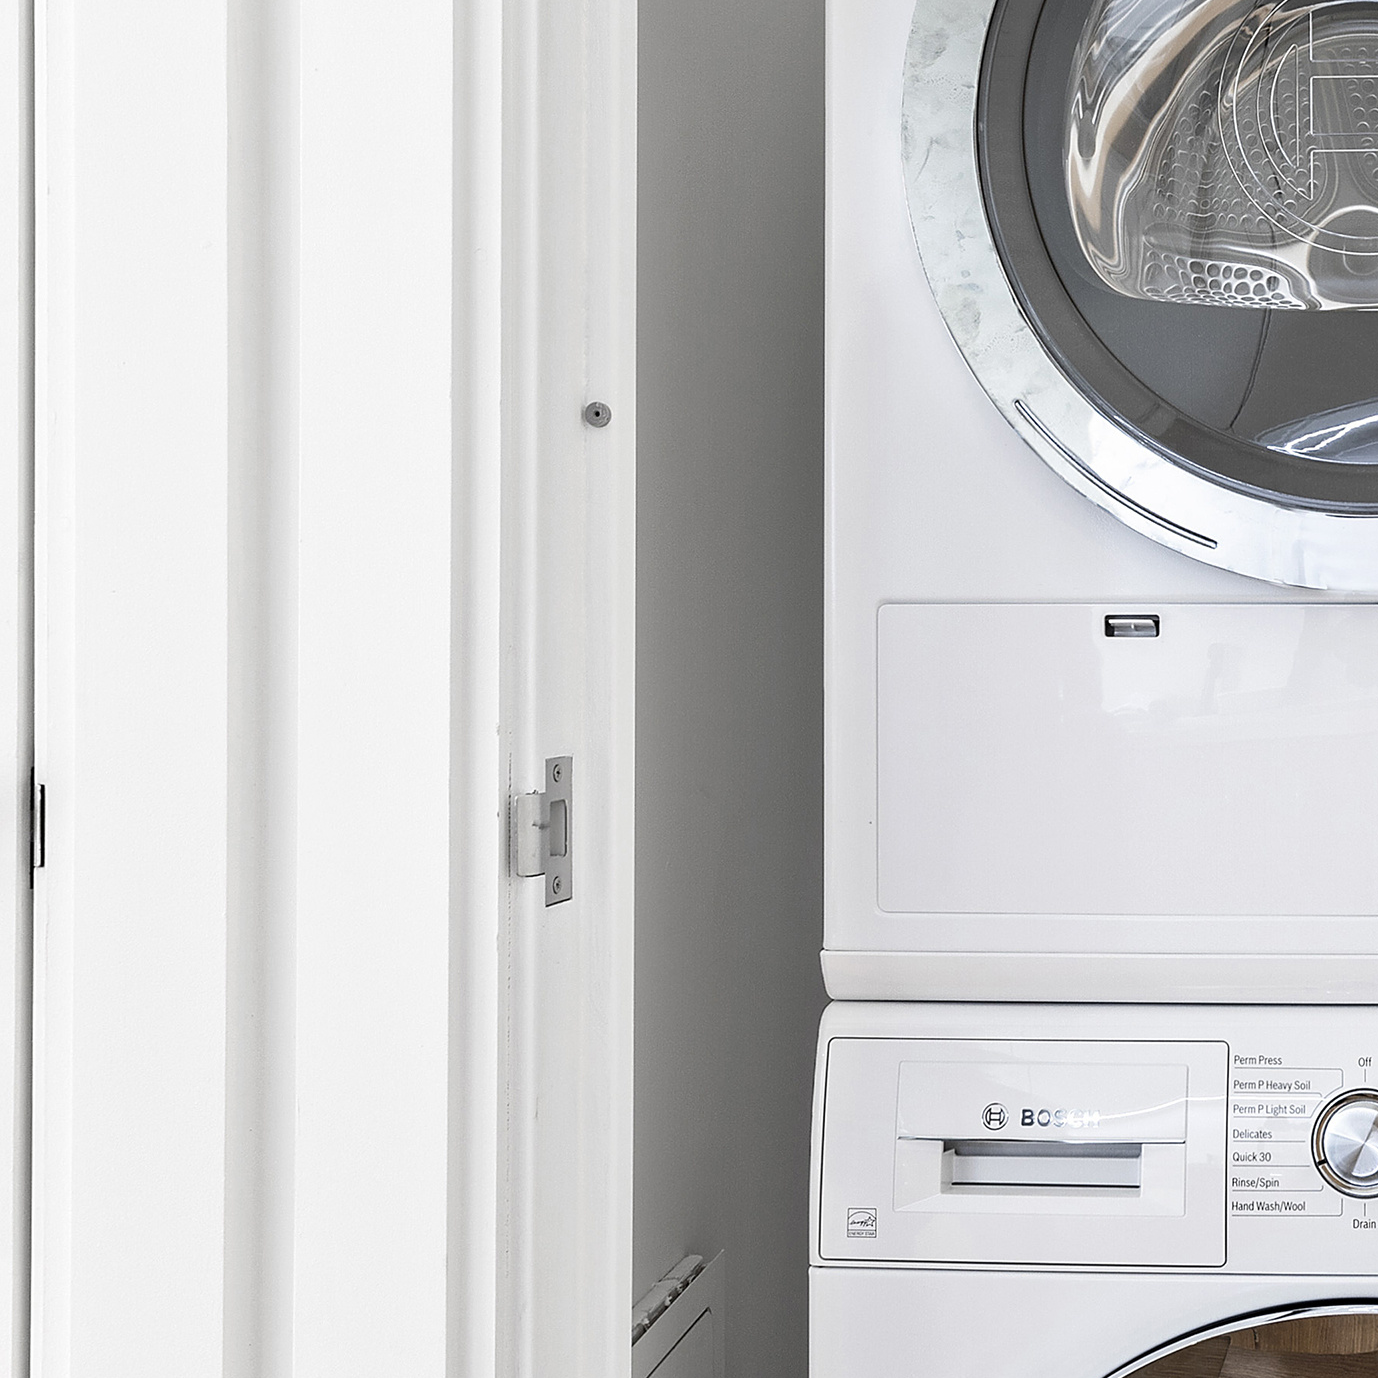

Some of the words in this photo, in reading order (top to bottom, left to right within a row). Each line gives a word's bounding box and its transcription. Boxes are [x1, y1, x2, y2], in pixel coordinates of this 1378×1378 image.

[1234, 1055, 1256, 1064] Perm
[1259, 1055, 1282, 1065] Press
[1358, 1057, 1372, 1067] Off
[1234, 1080, 1256, 1089] Perm
[1258, 1080, 1264, 1089] P
[1266, 1081, 1292, 1092] Heavy
[1294, 1081, 1310, 1090] Soil
[1233, 1104, 1256, 1114] Perm
[1258, 1104, 1264, 1113] P
[1266, 1105, 1287, 1116] Light
[1290, 1105, 1305, 1114] Soil
[1233, 1129, 1272, 1139] Delicates
[1233, 1152, 1257, 1161] Quick
[1259, 1152, 1271, 1161] 30
[1232, 1177, 1279, 1188] Rinse/Spin
[1232, 1201, 1254, 1211] Hand
[1256, 1201, 1305, 1212] Wash/Wool
[1353, 1219, 1376, 1229] Drain
